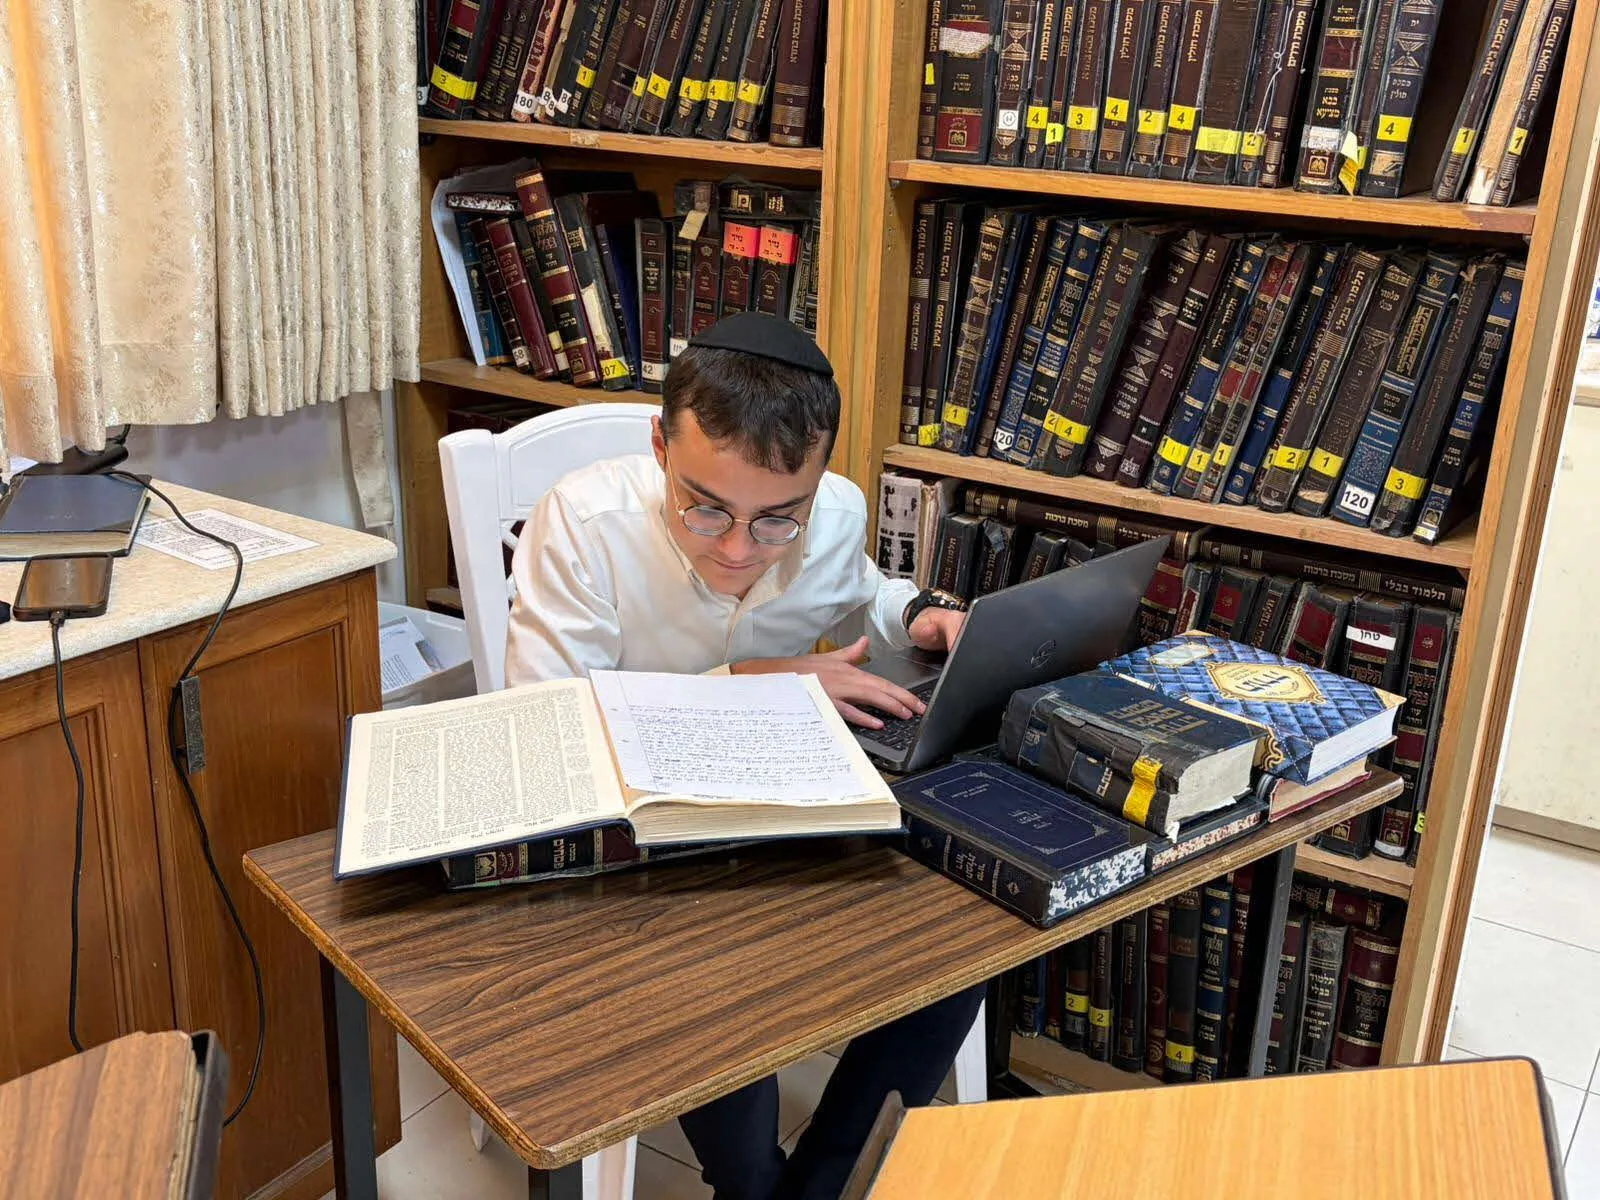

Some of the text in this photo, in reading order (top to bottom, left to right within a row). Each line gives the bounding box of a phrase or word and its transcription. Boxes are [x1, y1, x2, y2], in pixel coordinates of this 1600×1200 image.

[932, 0, 941, 26] מסכת
[1043, 3, 1053, 29] מסכת
[1161, 5, 1171, 32] מסכת
[1063, 6, 1073, 33] מסכת
[1120, 7, 1135, 58] מסכת חולין
[1188, 9, 1203, 62] מסכת חולין
[1287, 10, 1306, 67] מסכת נדרים
[1482, 17, 1509, 76] מסכת ביצה
[1527, 15, 1562, 100] מסכת ראש השנה
[440, 74, 448, 84] 3
[582, 70, 587, 80] 1
[652, 82, 660, 92] 4
[684, 85, 691, 96] 4
[709, 85, 716, 95] 4
[741, 82, 750, 92] 2
[514, 94, 533, 109] 180
[1322, 95, 1338, 105] בבא
[1111, 105, 1119, 116] 4
[1144, 110, 1153, 122] 2
[1316, 108, 1340, 119] מציעא
[1032, 113, 1039, 124] 4
[1075, 113, 1083, 125] 3
[1177, 112, 1185, 124] 4
[1051, 128, 1056, 139] 1
[1385, 121, 1394, 135] 4
[1462, 131, 1469, 143] 1
[1515, 135, 1523, 149] 1
[946, 222, 954, 251] תלמוד
[1335, 270, 1366, 331] תלמוד בבלי
[934, 304, 945, 328] מסכת
[952, 409, 958, 418] 1
[1064, 425, 1073, 437] 4
[994, 431, 1012, 445] 120
[1196, 454, 1201, 465] 1
[1218, 449, 1224, 460] 1
[1286, 452, 1296, 464] 2
[1322, 456, 1330, 468] 1
[1395, 478, 1404, 490] 3
[1344, 491, 1369, 509] 120
[1045, 512, 1088, 528] מסכת ברכות
[1303, 564, 1356, 582] מסכת ברכות
[1385, 579, 1446, 601] תלמוד בבלי
[1360, 630, 1381, 641] טחן
[553, 838, 565, 869] פסחים
[1310, 972, 1335, 984] תלמוד
[1311, 985, 1330, 996] בבלי
[1068, 998, 1074, 1008] 2
[1096, 1012, 1104, 1022] 2
[1175, 1050, 1183, 1060] 4
